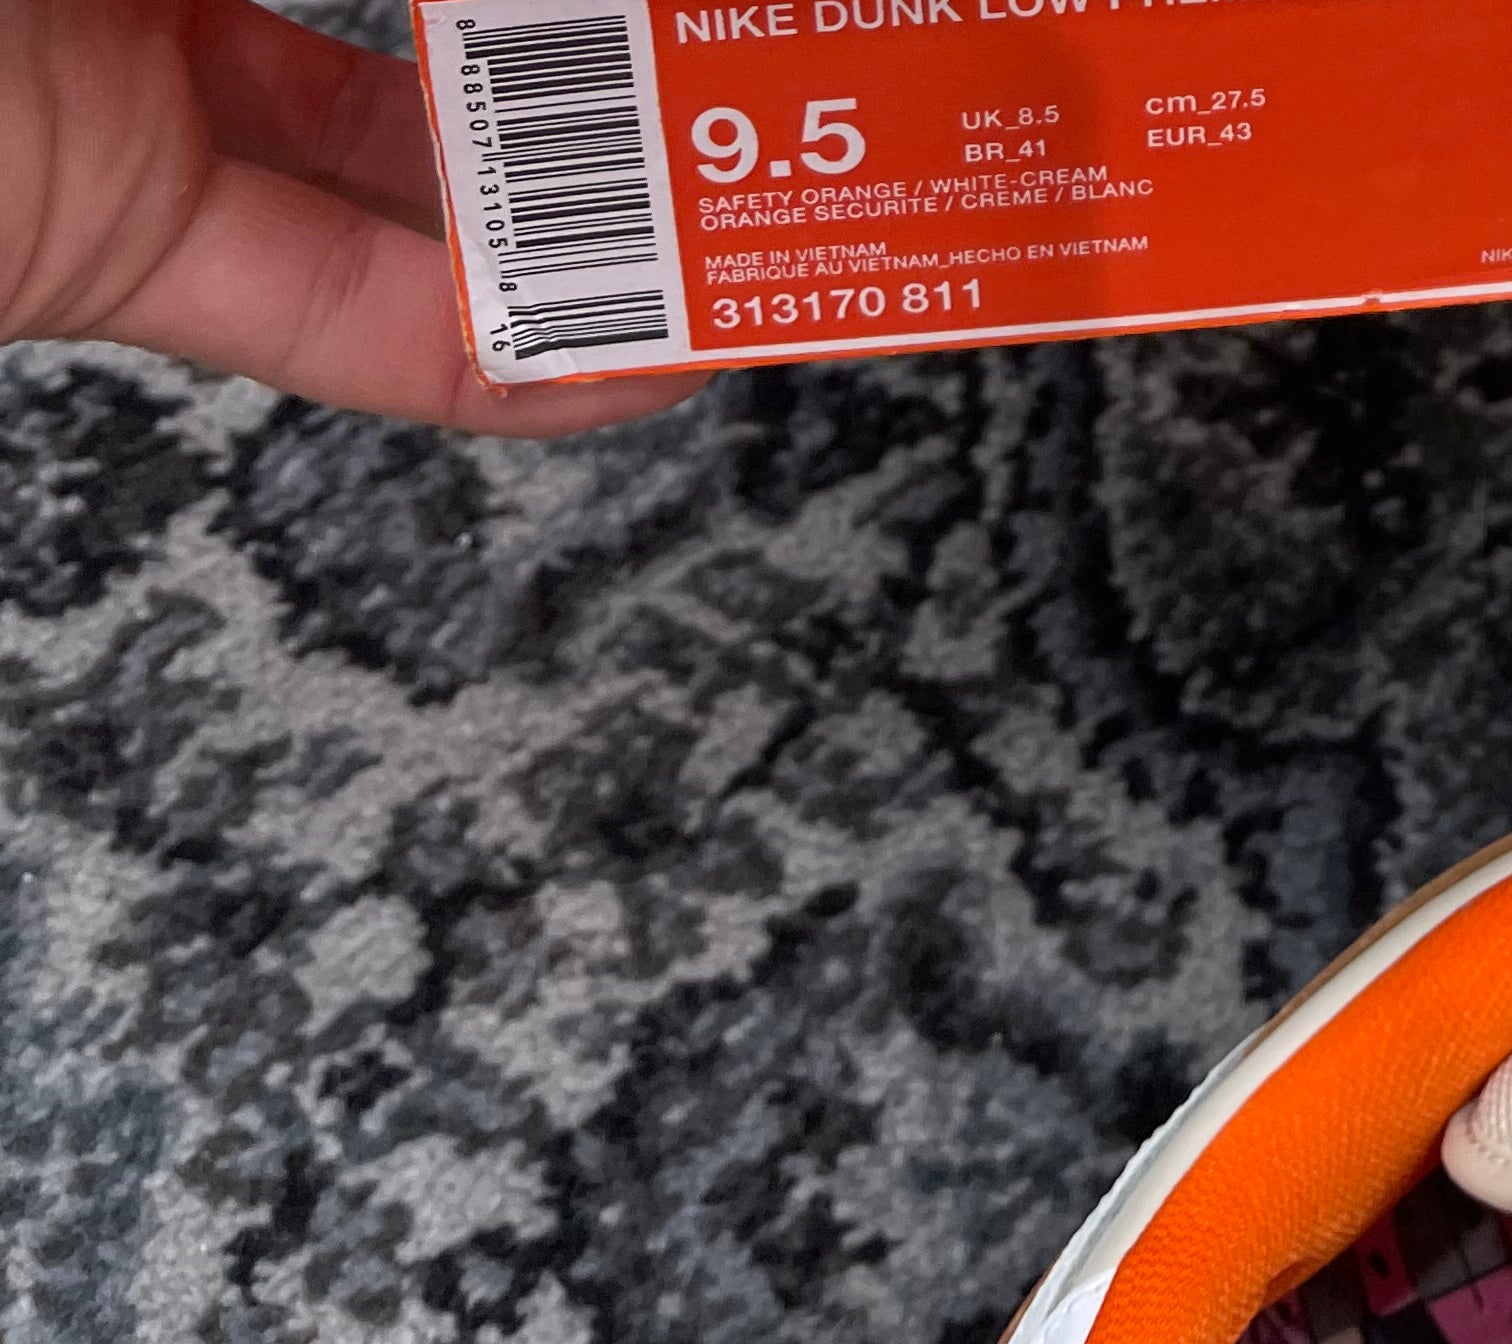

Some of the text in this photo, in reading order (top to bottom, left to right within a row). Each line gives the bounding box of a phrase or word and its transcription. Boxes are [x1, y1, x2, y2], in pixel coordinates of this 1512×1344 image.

[676, 3, 797, 44] NIKE
[961, 105, 1060, 130] UK_8.5
[1145, 88, 1266, 115] cm_27.5
[691, 98, 866, 183] 9.5
[965, 139, 1046, 162] BR_41
[1147, 122, 1252, 148] EUR_43
[698, 166, 1108, 214] SAFETY ORANGE / WHITE-CREAM
[701, 179, 1154, 231] ORANGE SECURITE / CREME / BLANC
[705, 242, 886, 269] MADE IN VIETNAM
[707, 263, 808, 285] FABRIQUE
[815, 260, 843, 275] AU
[1027, 243, 1054, 259] EN
[1059, 236, 1149, 256] VIETNAM
[712, 278, 981, 329] 313170 811
